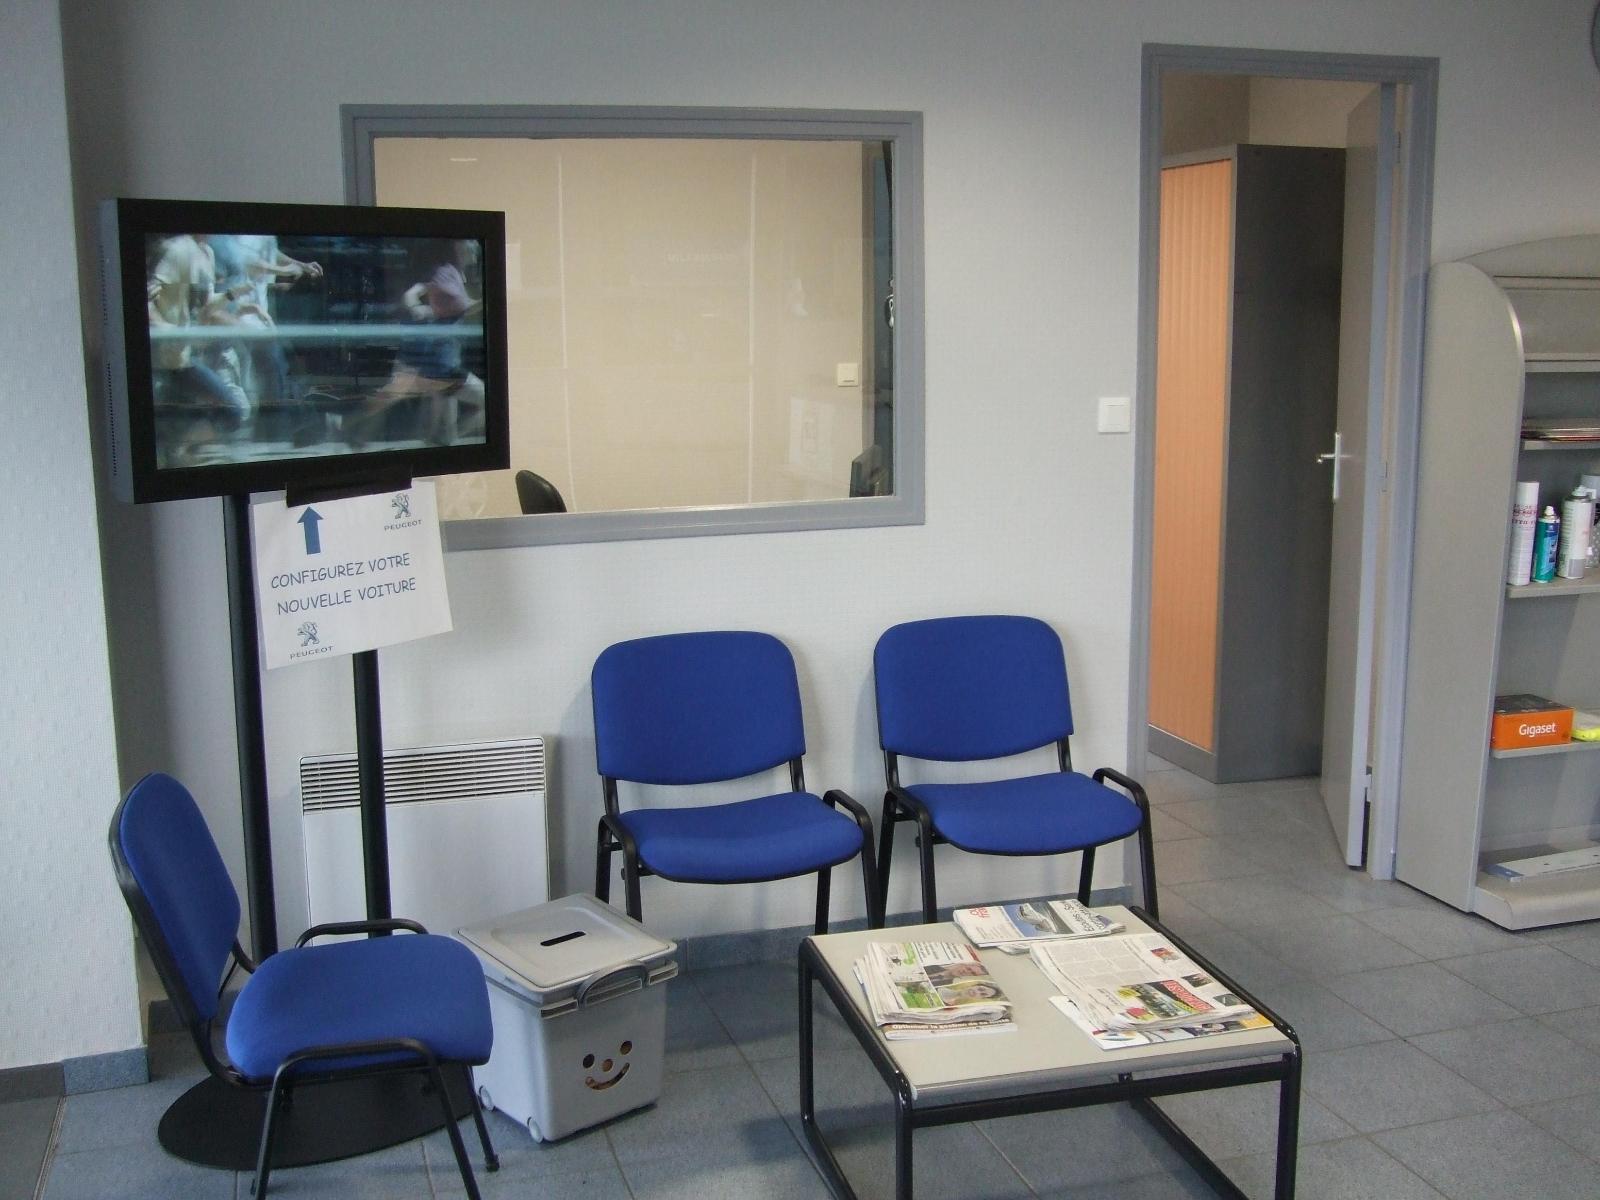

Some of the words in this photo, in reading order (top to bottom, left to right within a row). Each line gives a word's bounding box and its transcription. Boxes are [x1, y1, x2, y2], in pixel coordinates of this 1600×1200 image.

[384, 520, 422, 532] PEUGEOT
[271, 562, 365, 589] CONFIGUREZ
[368, 552, 411, 572] VOTRE
[277, 589, 352, 615] NOUVELLE
[358, 577, 416, 601] VOITURE
[290, 646, 334, 659] PEUGEOT
[1518, 722, 1556, 738] Gigaset
